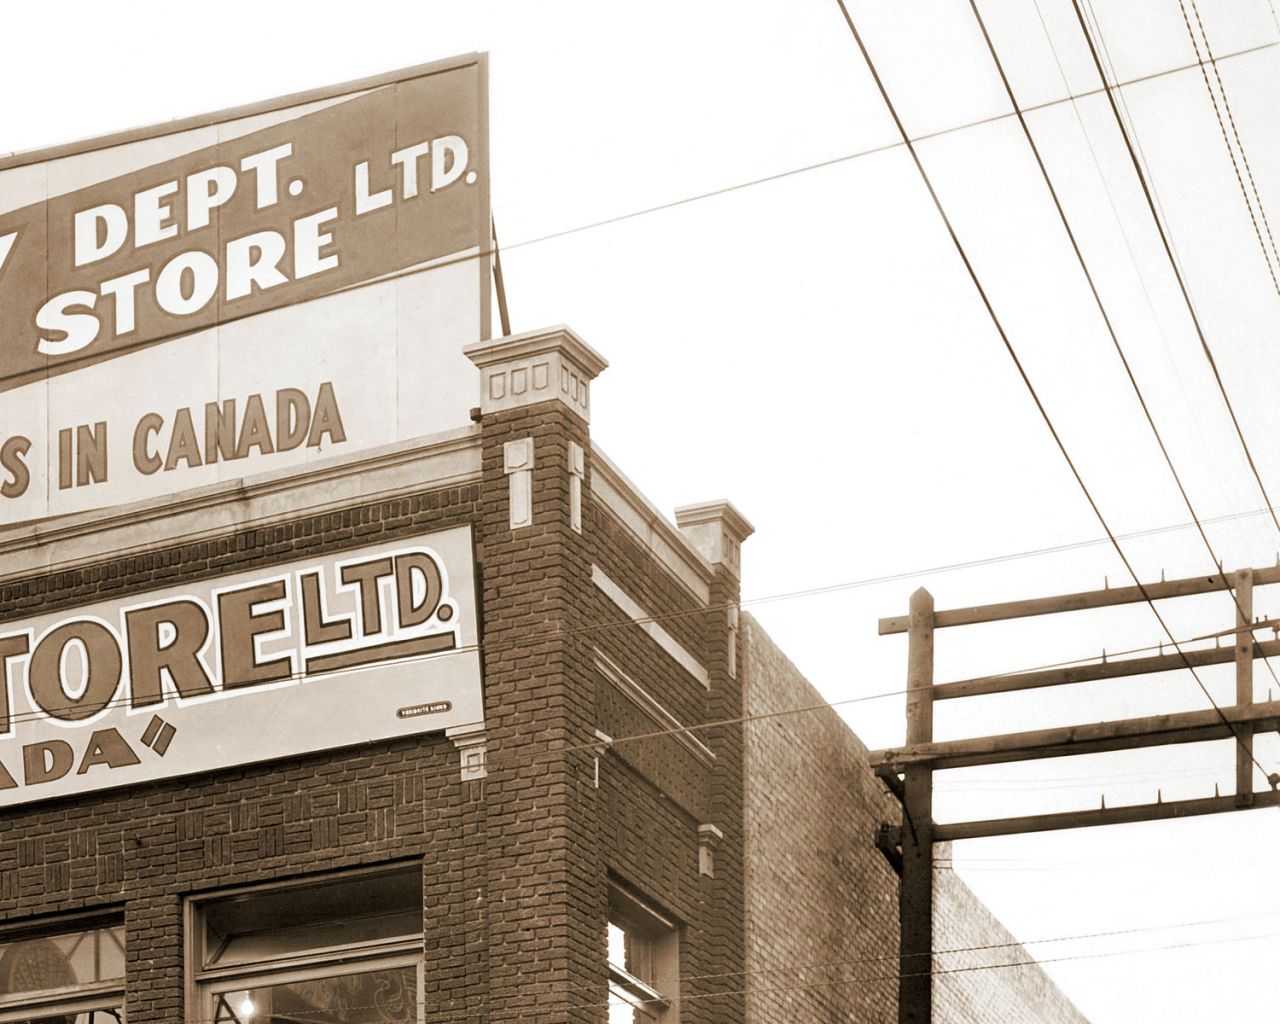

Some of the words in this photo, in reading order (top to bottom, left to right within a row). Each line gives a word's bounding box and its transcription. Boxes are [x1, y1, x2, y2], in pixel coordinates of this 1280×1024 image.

[74, 142, 304, 268] DEPT.
[355, 134, 478, 217] LTD.
[35, 206, 340, 355] STORE
[58, 420, 108, 490] IN
[132, 381, 347, 476] CANADA
[304, 552, 455, 646] LTD.
